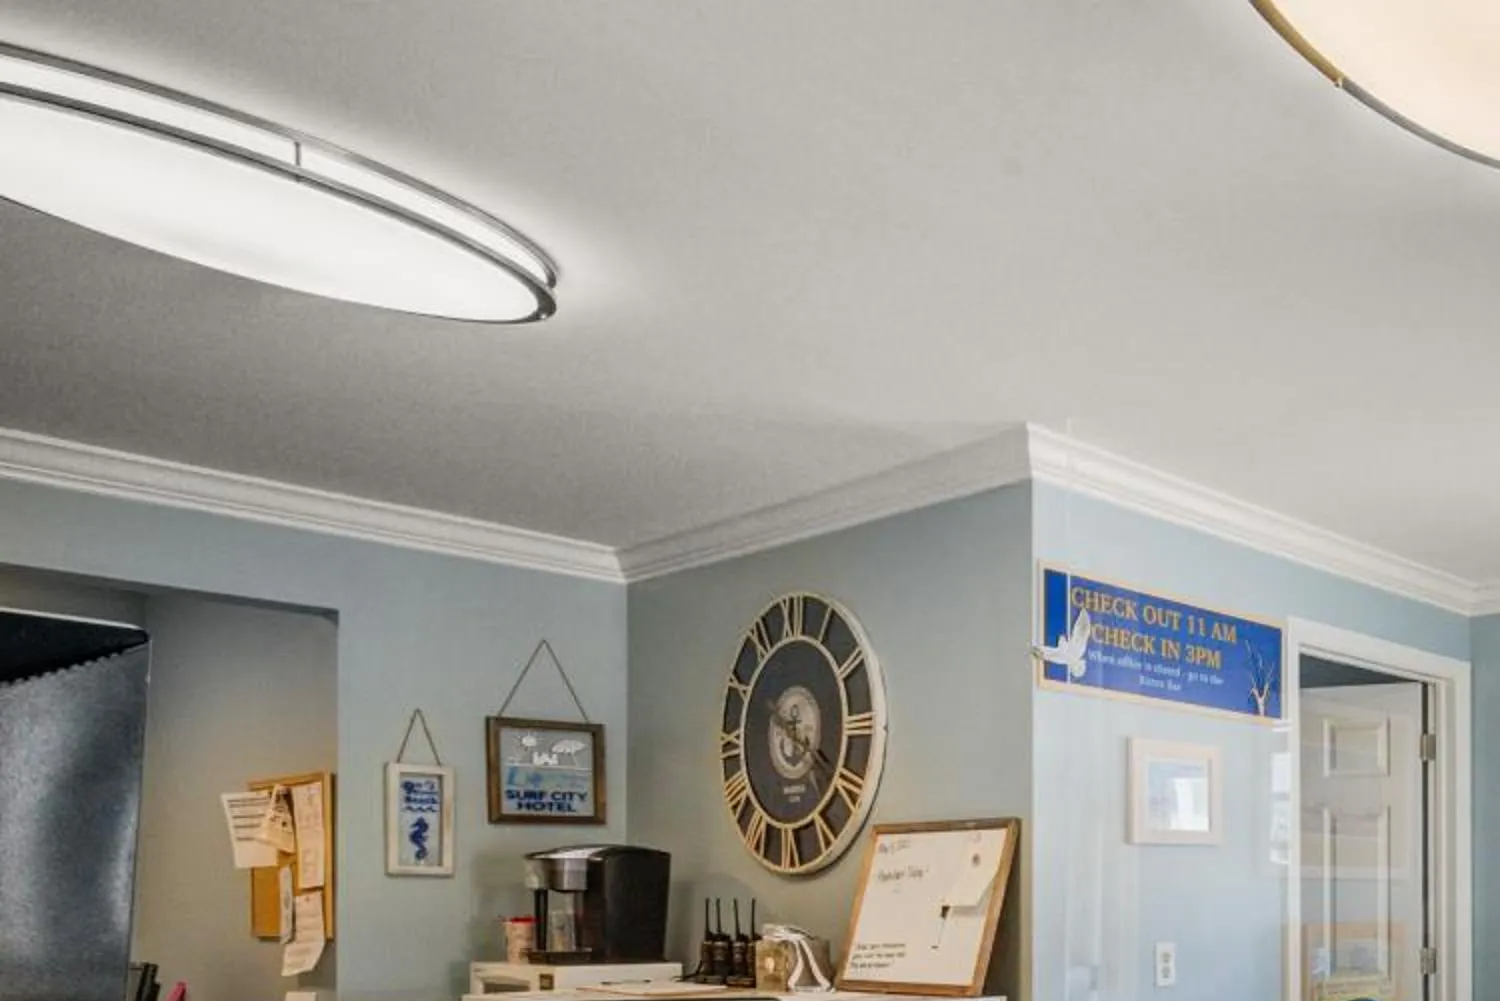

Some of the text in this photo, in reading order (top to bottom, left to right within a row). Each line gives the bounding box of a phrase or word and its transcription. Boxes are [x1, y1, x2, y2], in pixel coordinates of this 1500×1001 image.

[1071, 587, 1237, 644] CHECK OUT 11 AM
[1091, 624, 1222, 670] CHECK IN 3PM
[506, 790, 588, 802] SURF CITY
[517, 802, 576, 813] HOTEL
